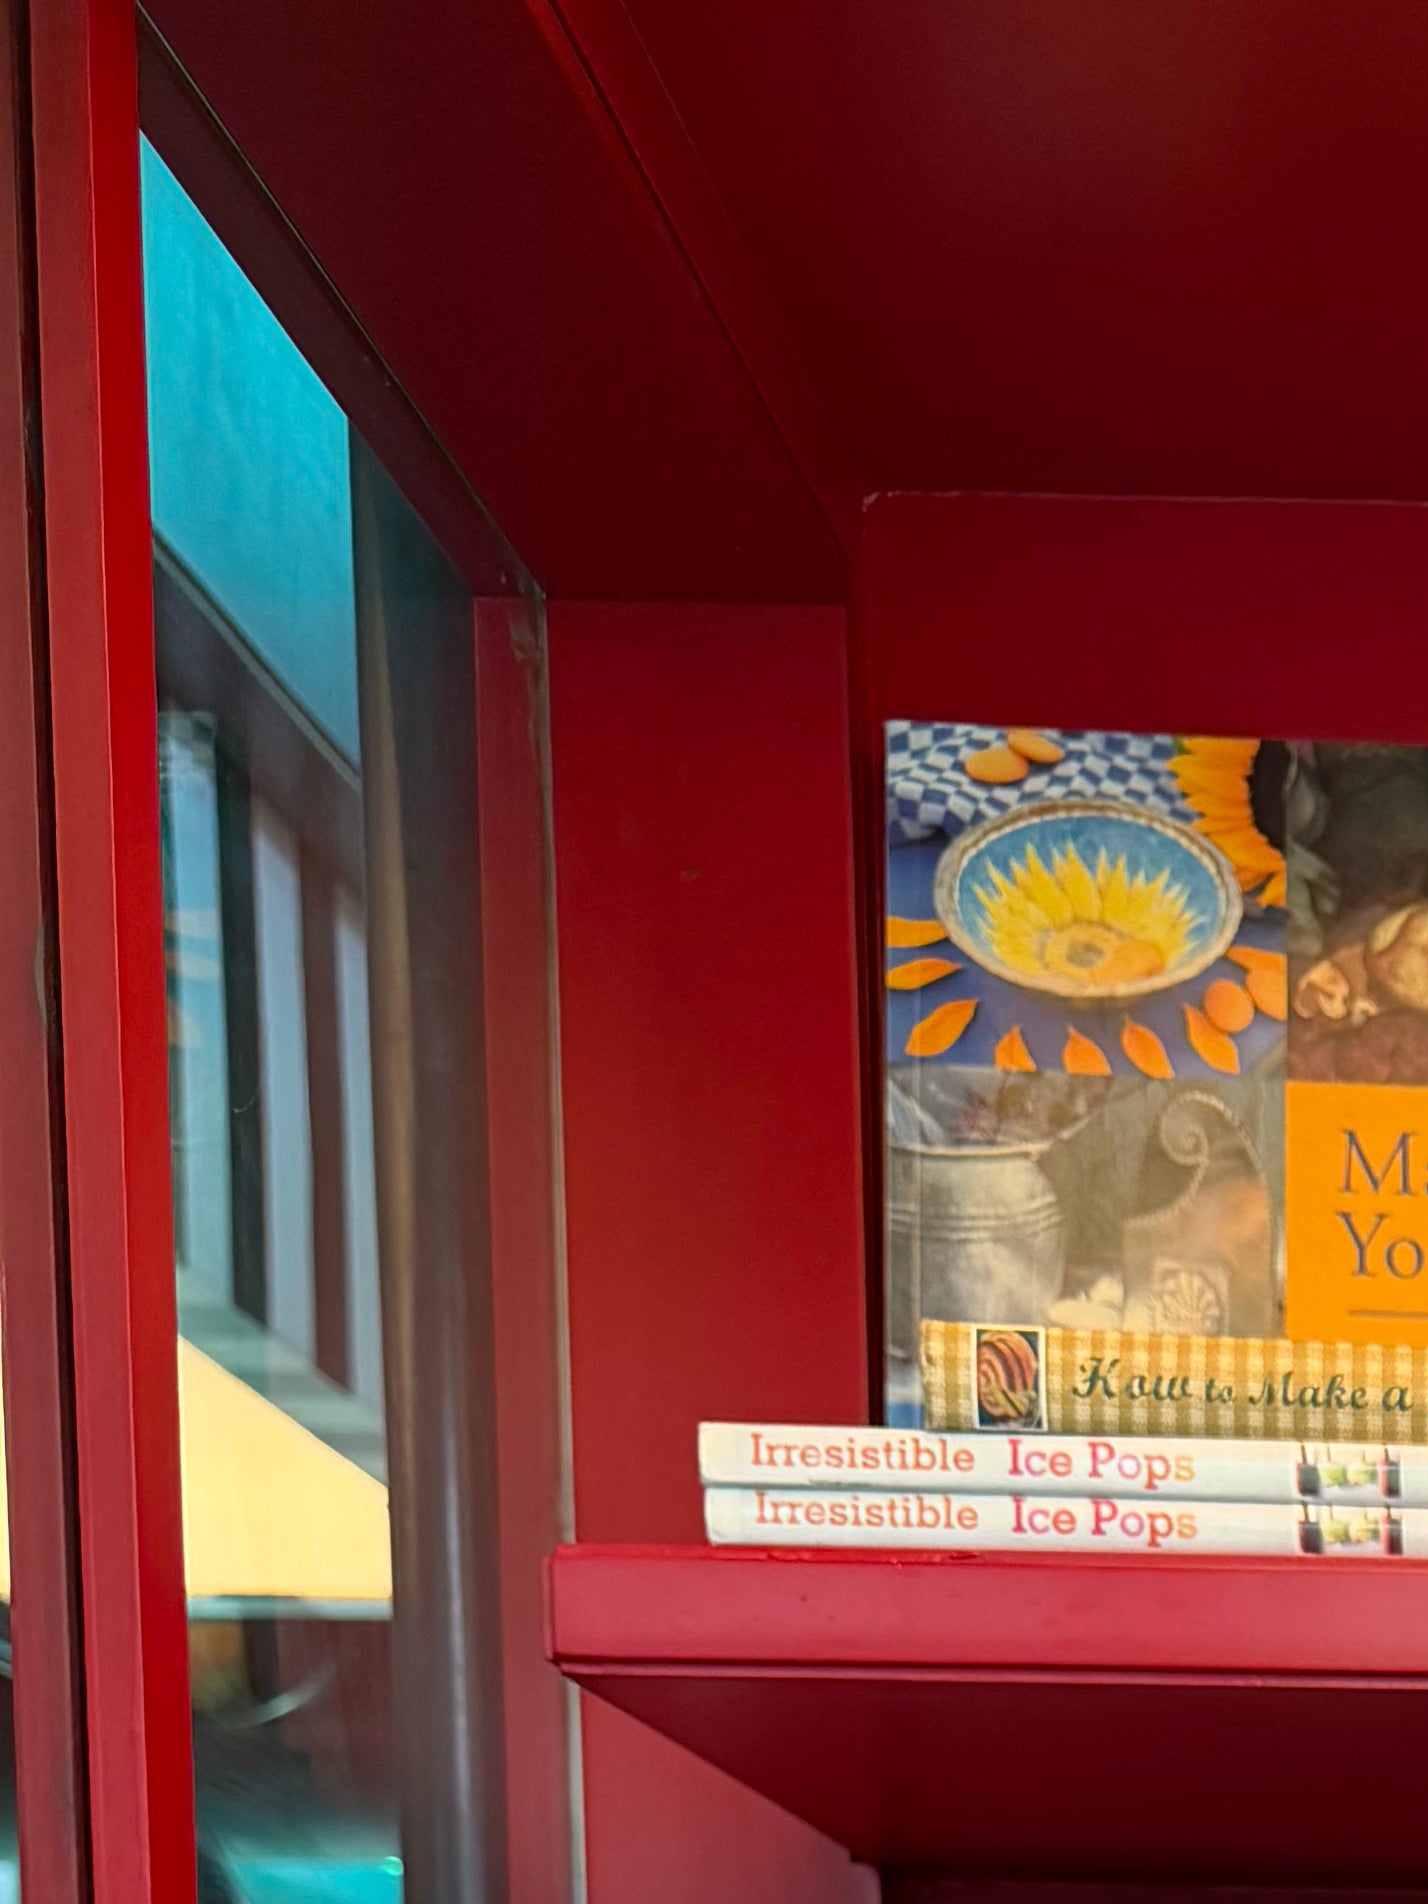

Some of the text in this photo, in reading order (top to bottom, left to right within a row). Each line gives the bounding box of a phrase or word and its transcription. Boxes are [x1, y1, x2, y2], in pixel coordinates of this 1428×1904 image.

[1072, 1357, 1193, 1402] How
[1205, 1374, 1235, 1402] to
[1248, 1369, 1367, 1413] Make
[1382, 1386, 1413, 1413] a
[750, 1432, 1196, 1490] Irresistible Ice Pops
[755, 1490, 1198, 1548] Irresistible Ice Pops
